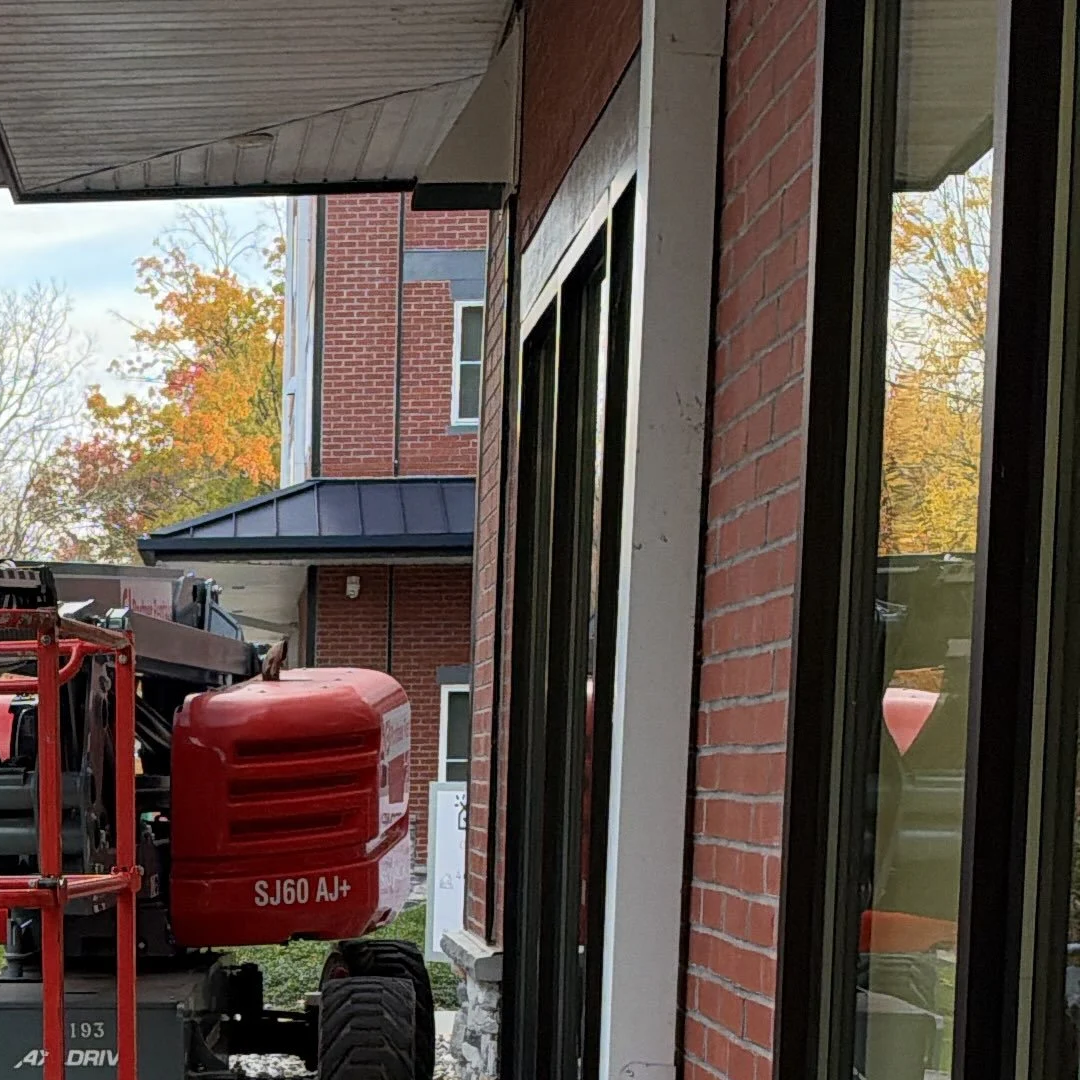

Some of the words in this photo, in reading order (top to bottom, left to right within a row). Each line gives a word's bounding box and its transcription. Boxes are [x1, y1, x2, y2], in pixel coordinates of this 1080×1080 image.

[254, 879, 309, 907] SJ60
[316, 875, 352, 902] AJ+
[70, 1022, 105, 1038] 193
